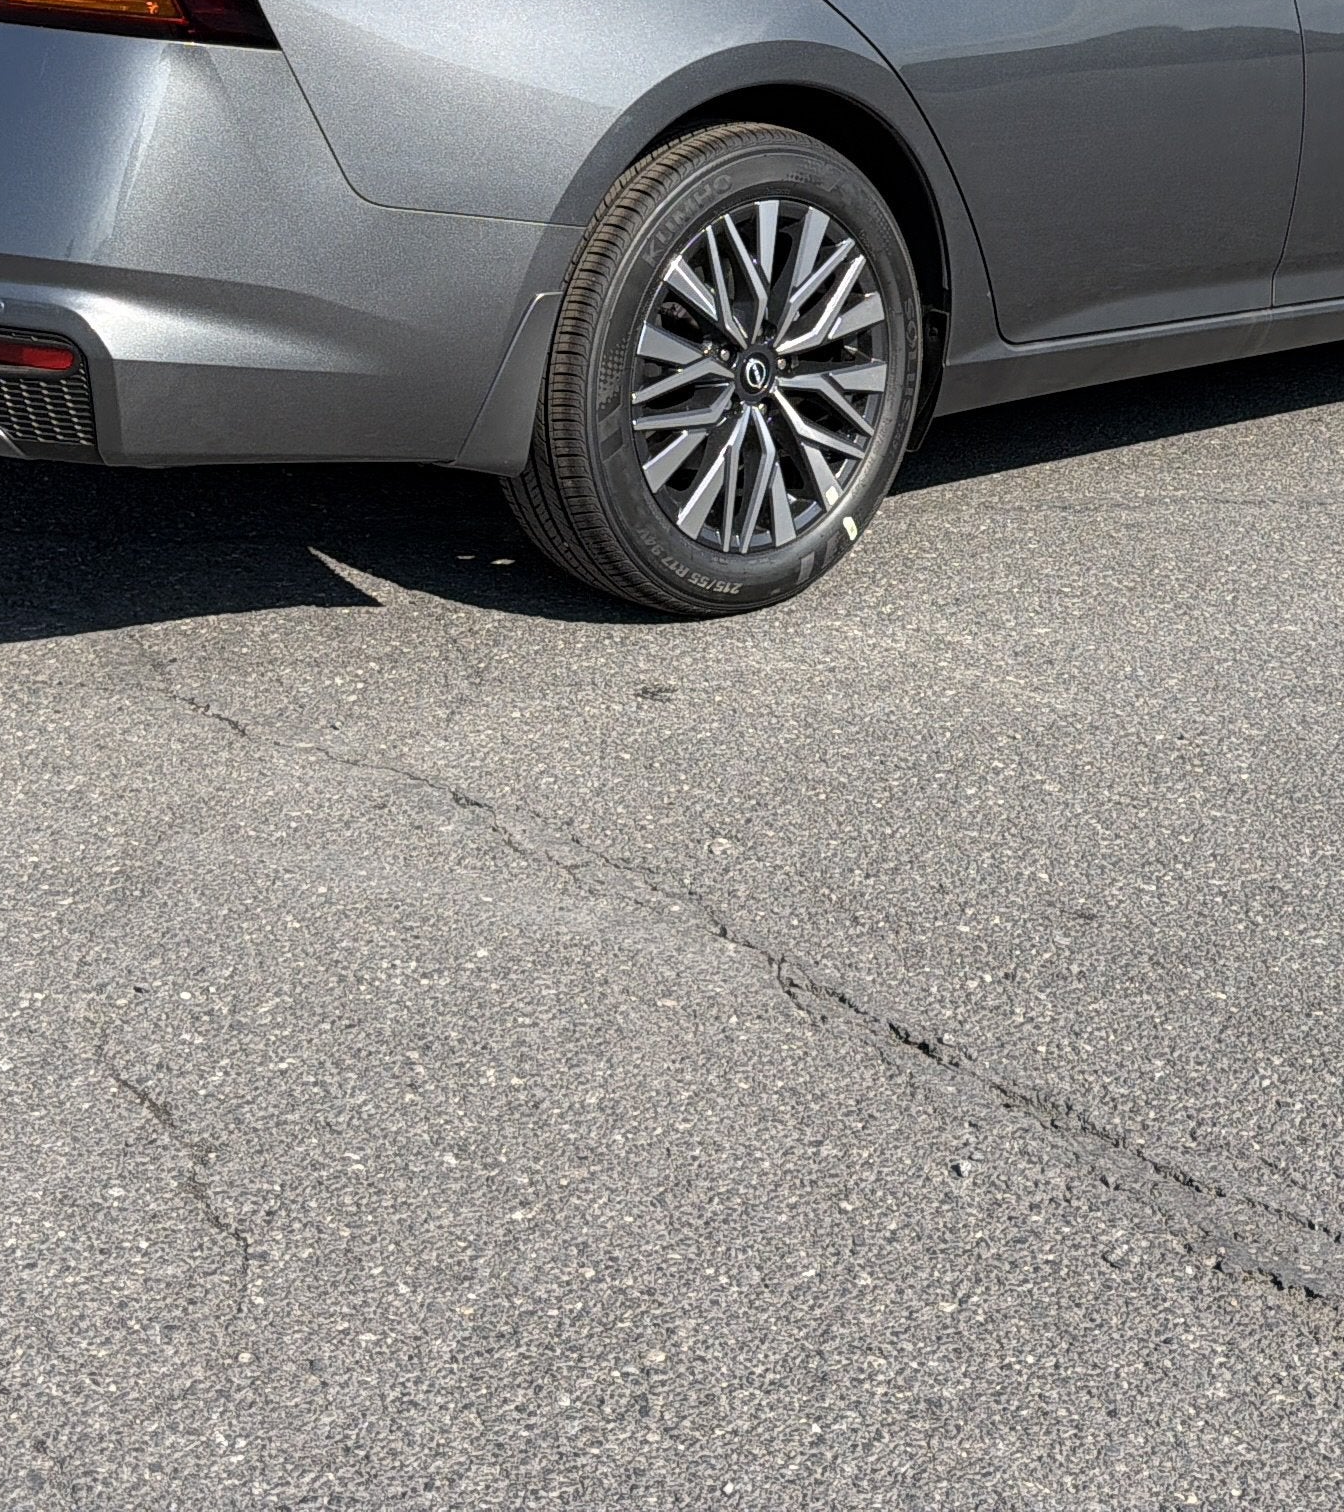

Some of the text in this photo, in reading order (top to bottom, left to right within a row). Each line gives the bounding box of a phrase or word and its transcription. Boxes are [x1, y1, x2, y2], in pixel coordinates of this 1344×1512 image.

[641, 174, 733, 269] KUMHO
[660, 556, 690, 578] R17
[687, 571, 744, 595] 215/55
